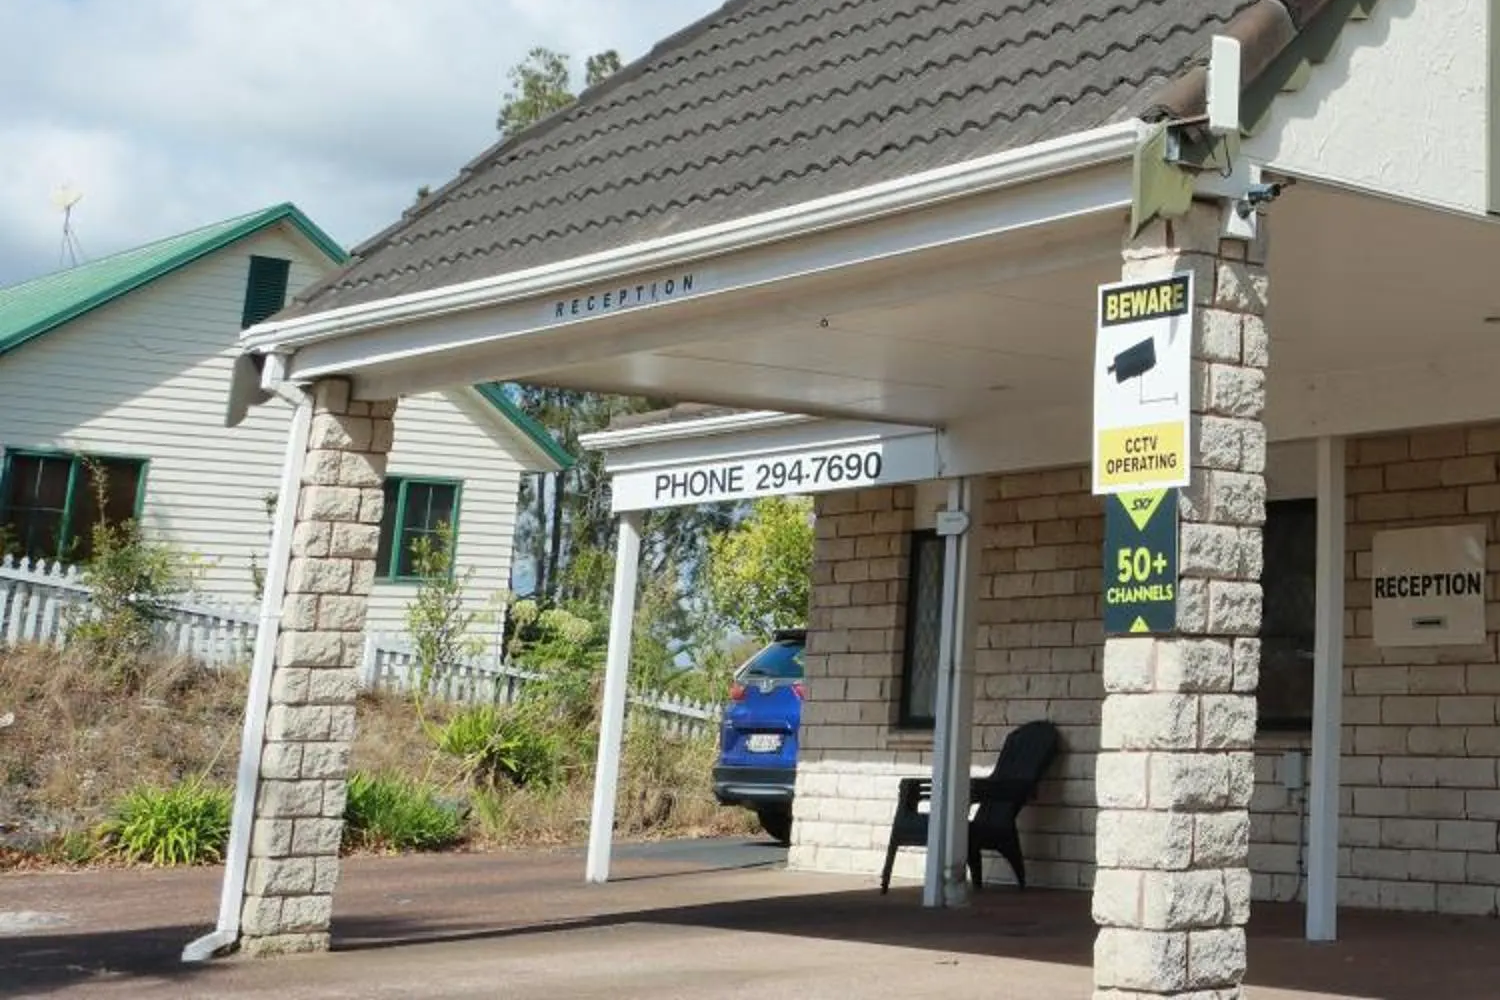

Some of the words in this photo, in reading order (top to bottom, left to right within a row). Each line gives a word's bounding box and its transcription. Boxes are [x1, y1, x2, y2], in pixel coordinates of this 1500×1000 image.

[556, 275, 694, 317] RECEPTION
[1106, 284, 1184, 321] BEWARE
[1125, 436, 1157, 453] CCTV
[1107, 453, 1177, 475] OPERATING
[655, 466, 744, 499] PHONE
[1118, 547, 1167, 583] 50+
[1107, 584, 1173, 604] CHANNELS
[1374, 572, 1482, 598] RECEPTION
